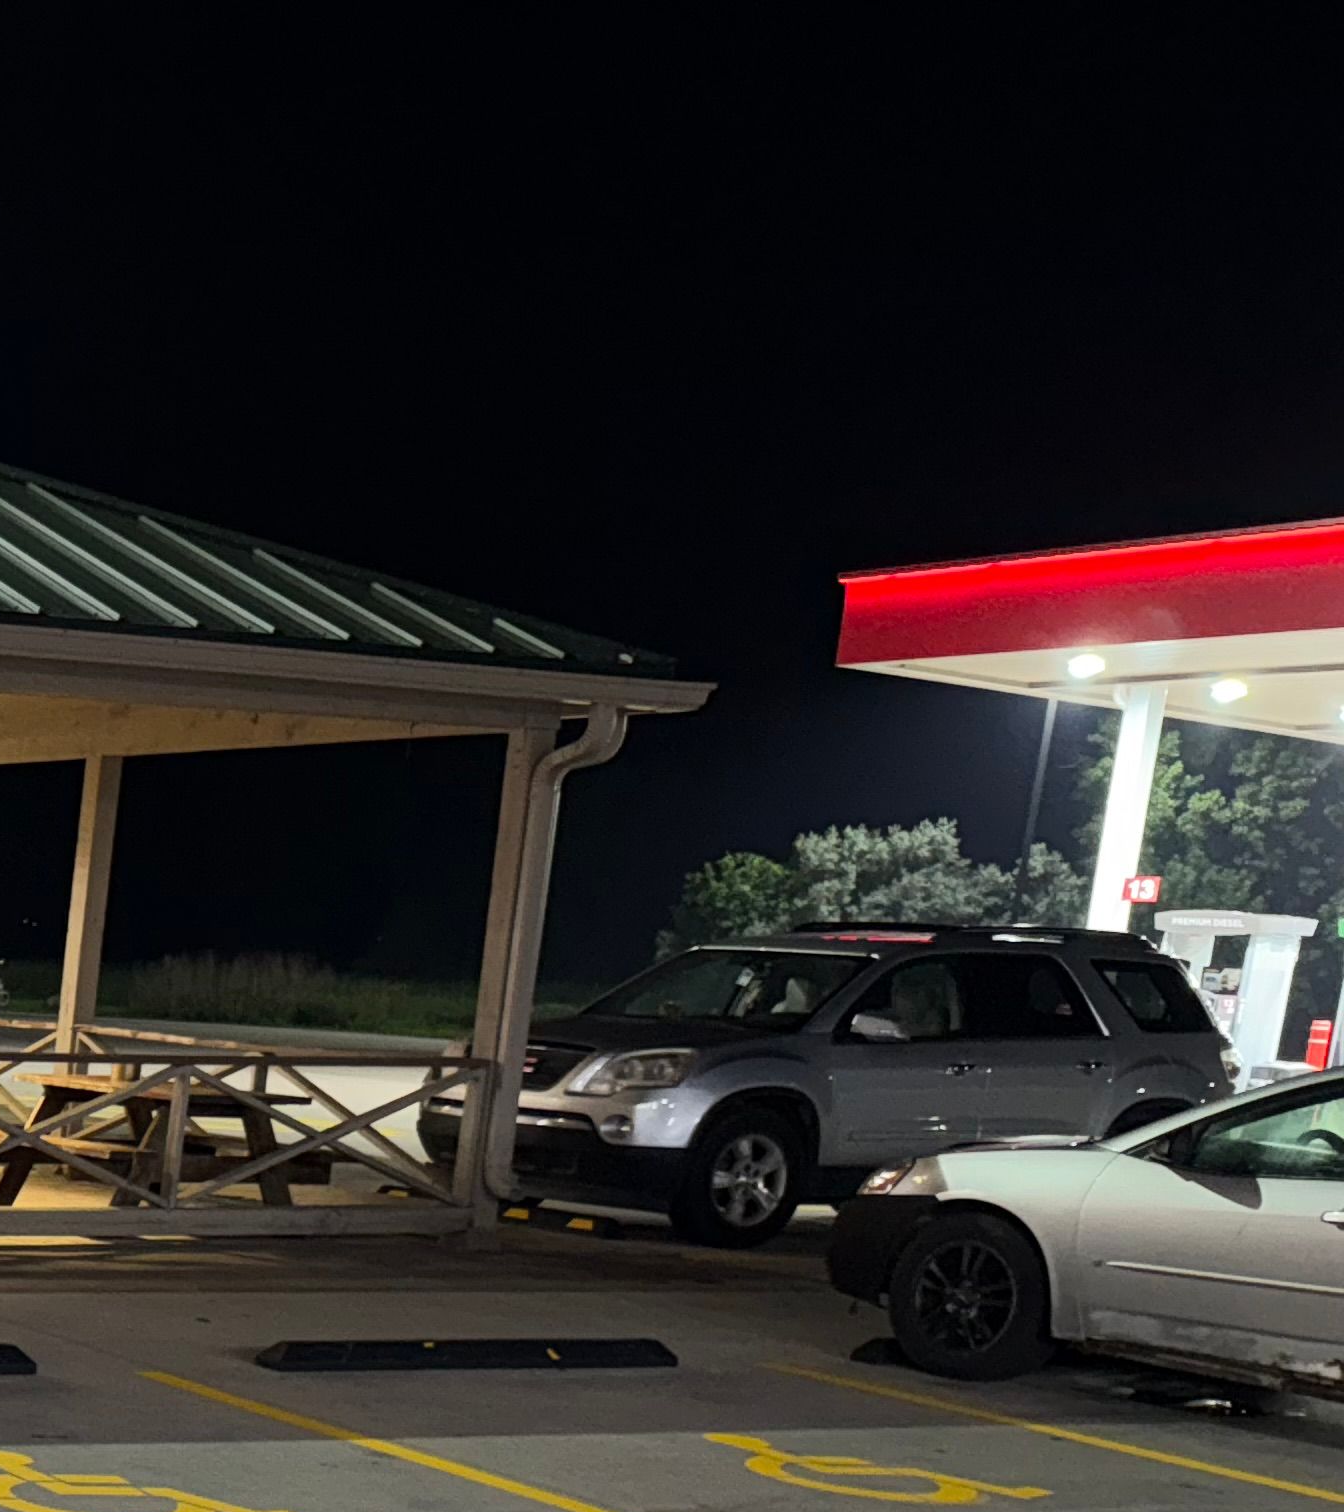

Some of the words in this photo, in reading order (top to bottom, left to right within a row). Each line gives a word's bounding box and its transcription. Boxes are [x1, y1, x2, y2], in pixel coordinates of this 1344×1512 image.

[1128, 879, 1155, 899] 13
[1171, 916, 1211, 927] PREMIUM
[1212, 917, 1245, 929] DIESEL
